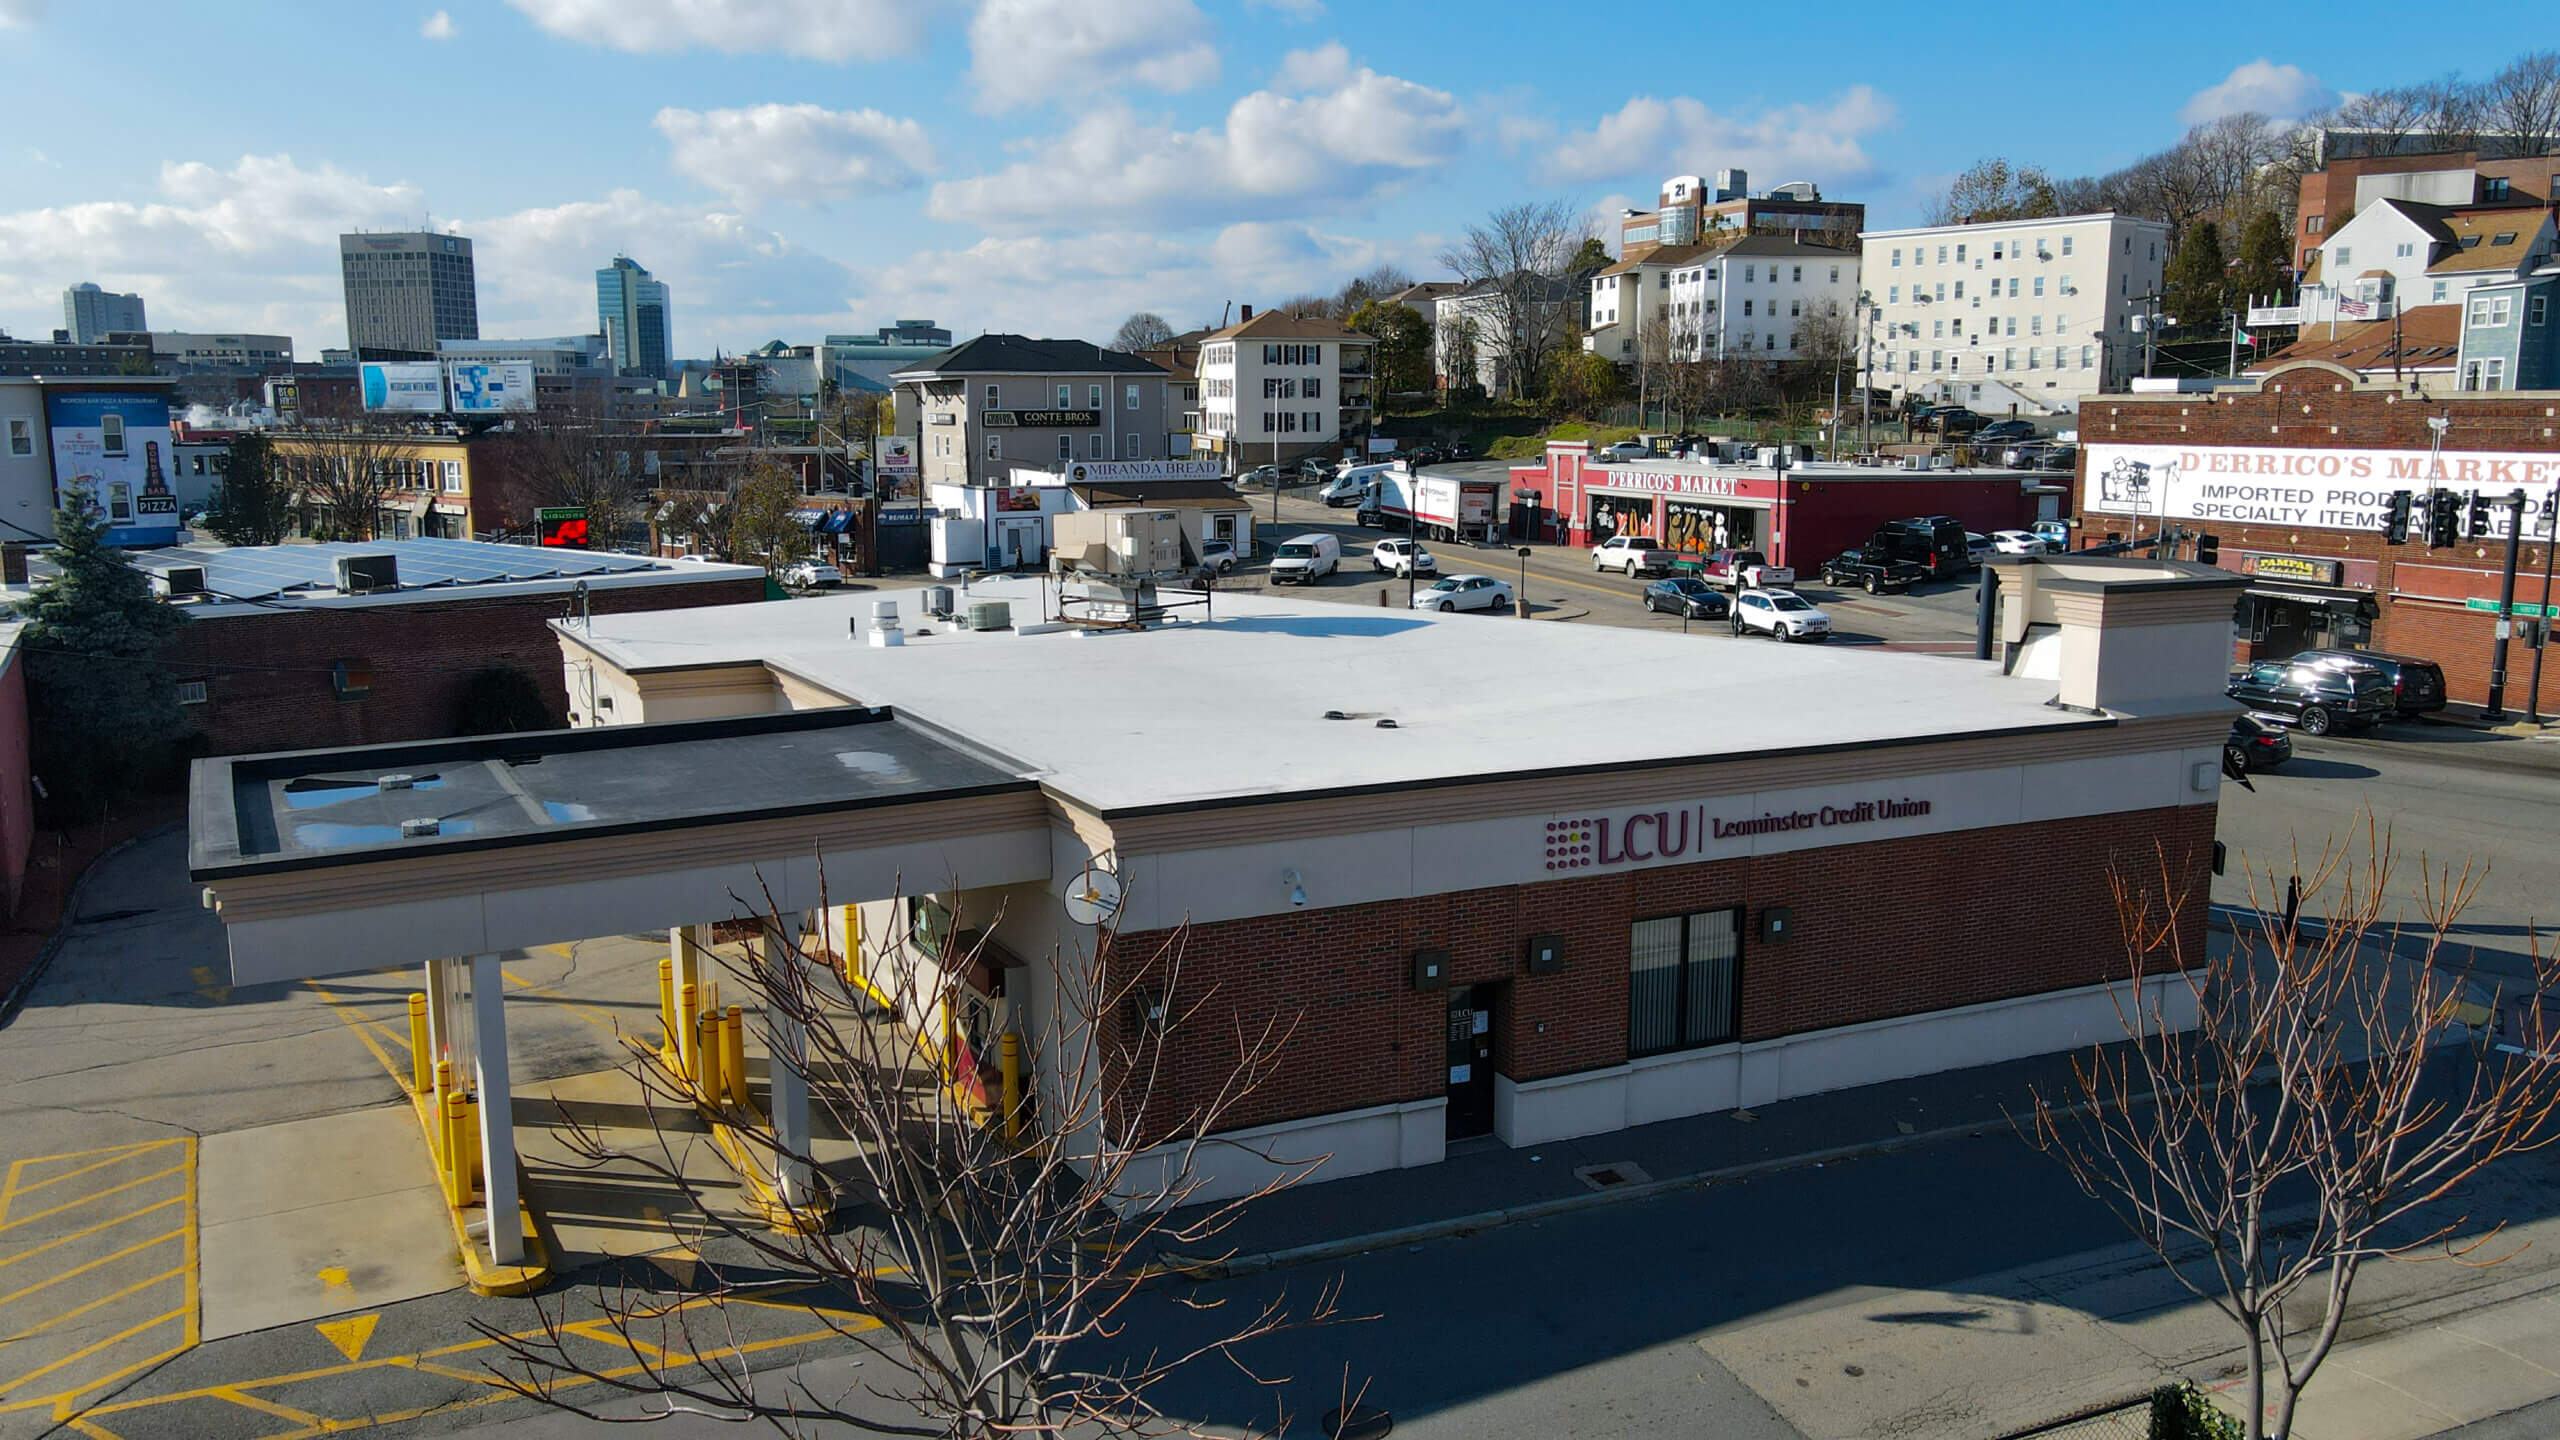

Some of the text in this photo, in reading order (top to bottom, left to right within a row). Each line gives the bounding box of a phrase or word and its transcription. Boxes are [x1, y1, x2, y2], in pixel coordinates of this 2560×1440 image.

[1024, 411, 1062, 422] CONTE
[1089, 462, 1216, 475] MIRANDA BREAD
[2180, 452, 2373, 478] D'ERRICO'S
[1607, 471, 1738, 496] D'ERRICO'S MARKET
[147, 487, 166, 496] BAR
[2201, 484, 2315, 505] IMPORTED
[139, 501, 177, 512] PIZZA
[2191, 502, 2308, 523] SPECIALTY
[888, 513, 914, 521] RE/MAX
[2259, 558, 2314, 571] PAMPAS
[1594, 797, 1932, 865] LCU Leominster Credit Union
[1458, 1008, 1473, 1018] LCU
